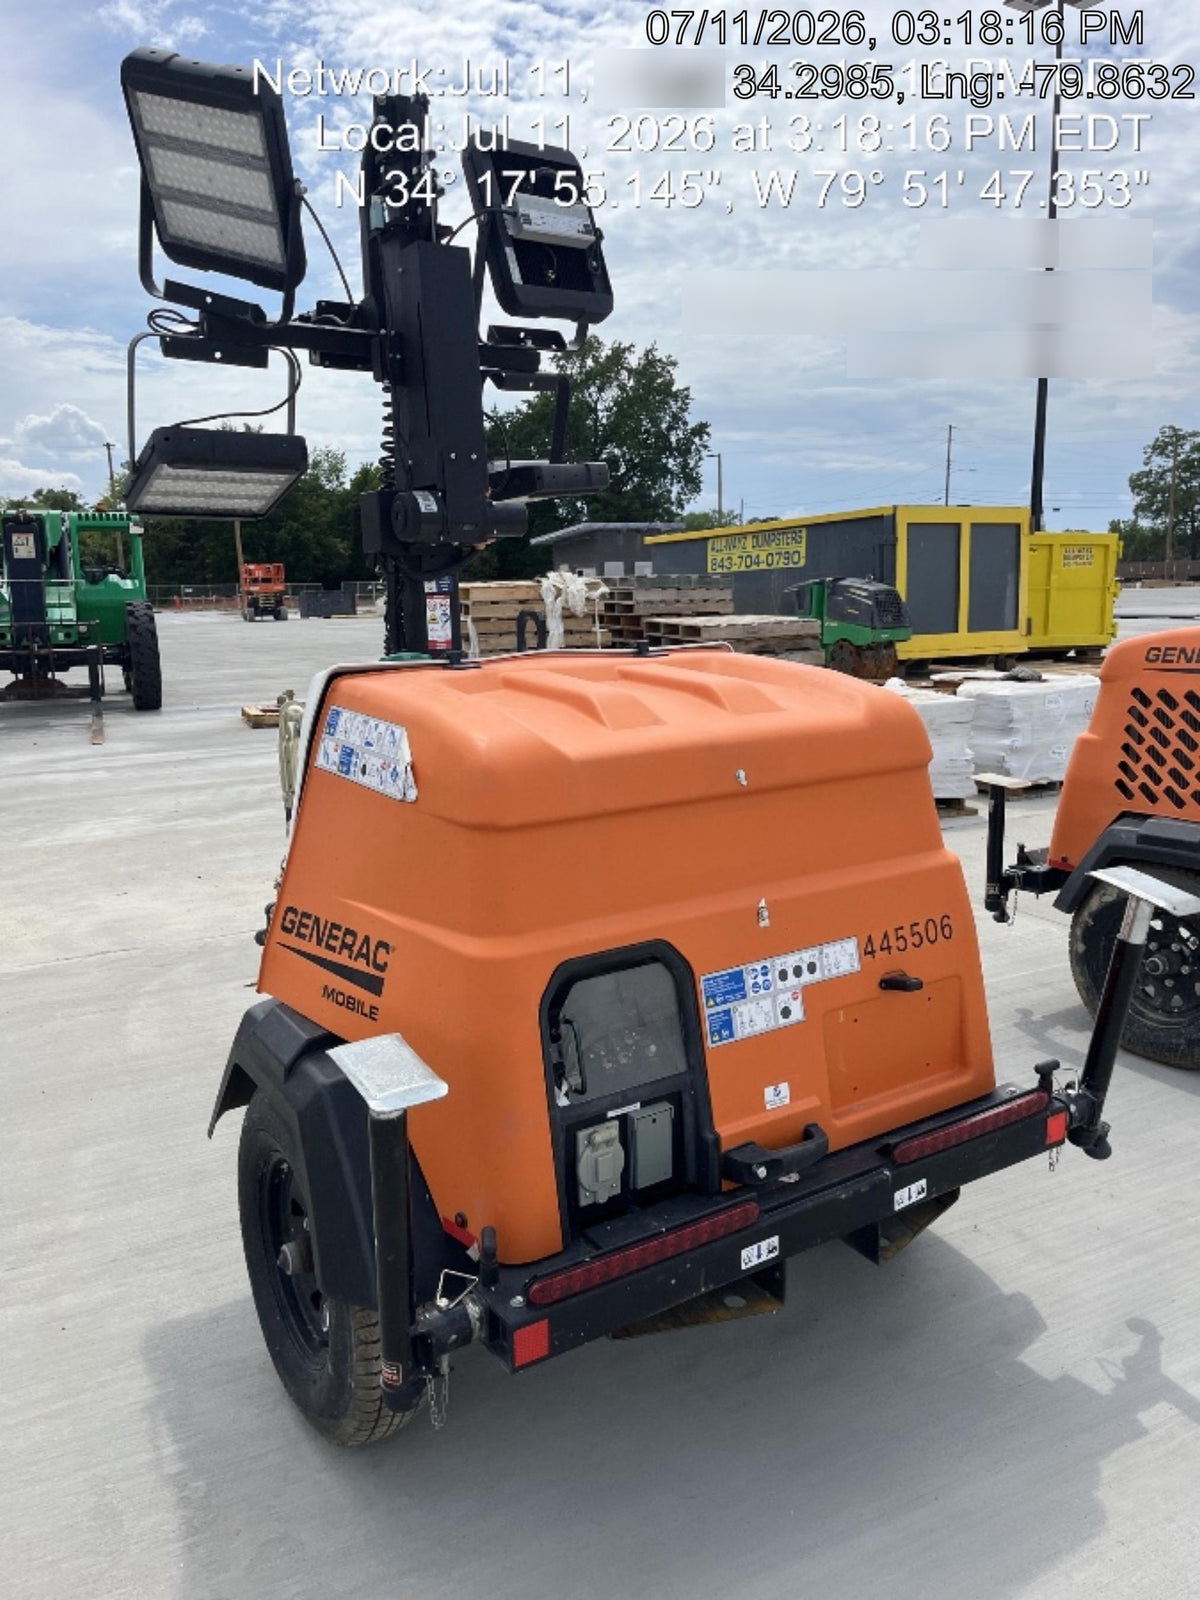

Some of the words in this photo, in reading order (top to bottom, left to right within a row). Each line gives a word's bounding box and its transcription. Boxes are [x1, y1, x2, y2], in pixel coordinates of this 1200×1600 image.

[752, 529, 803, 549] DUMPSTERS
[711, 550, 801, 571] 843-704-0790
[280, 906, 391, 973] GENERAC
[863, 914, 953, 959] 445506
[321, 985, 379, 1022] MOBILE
